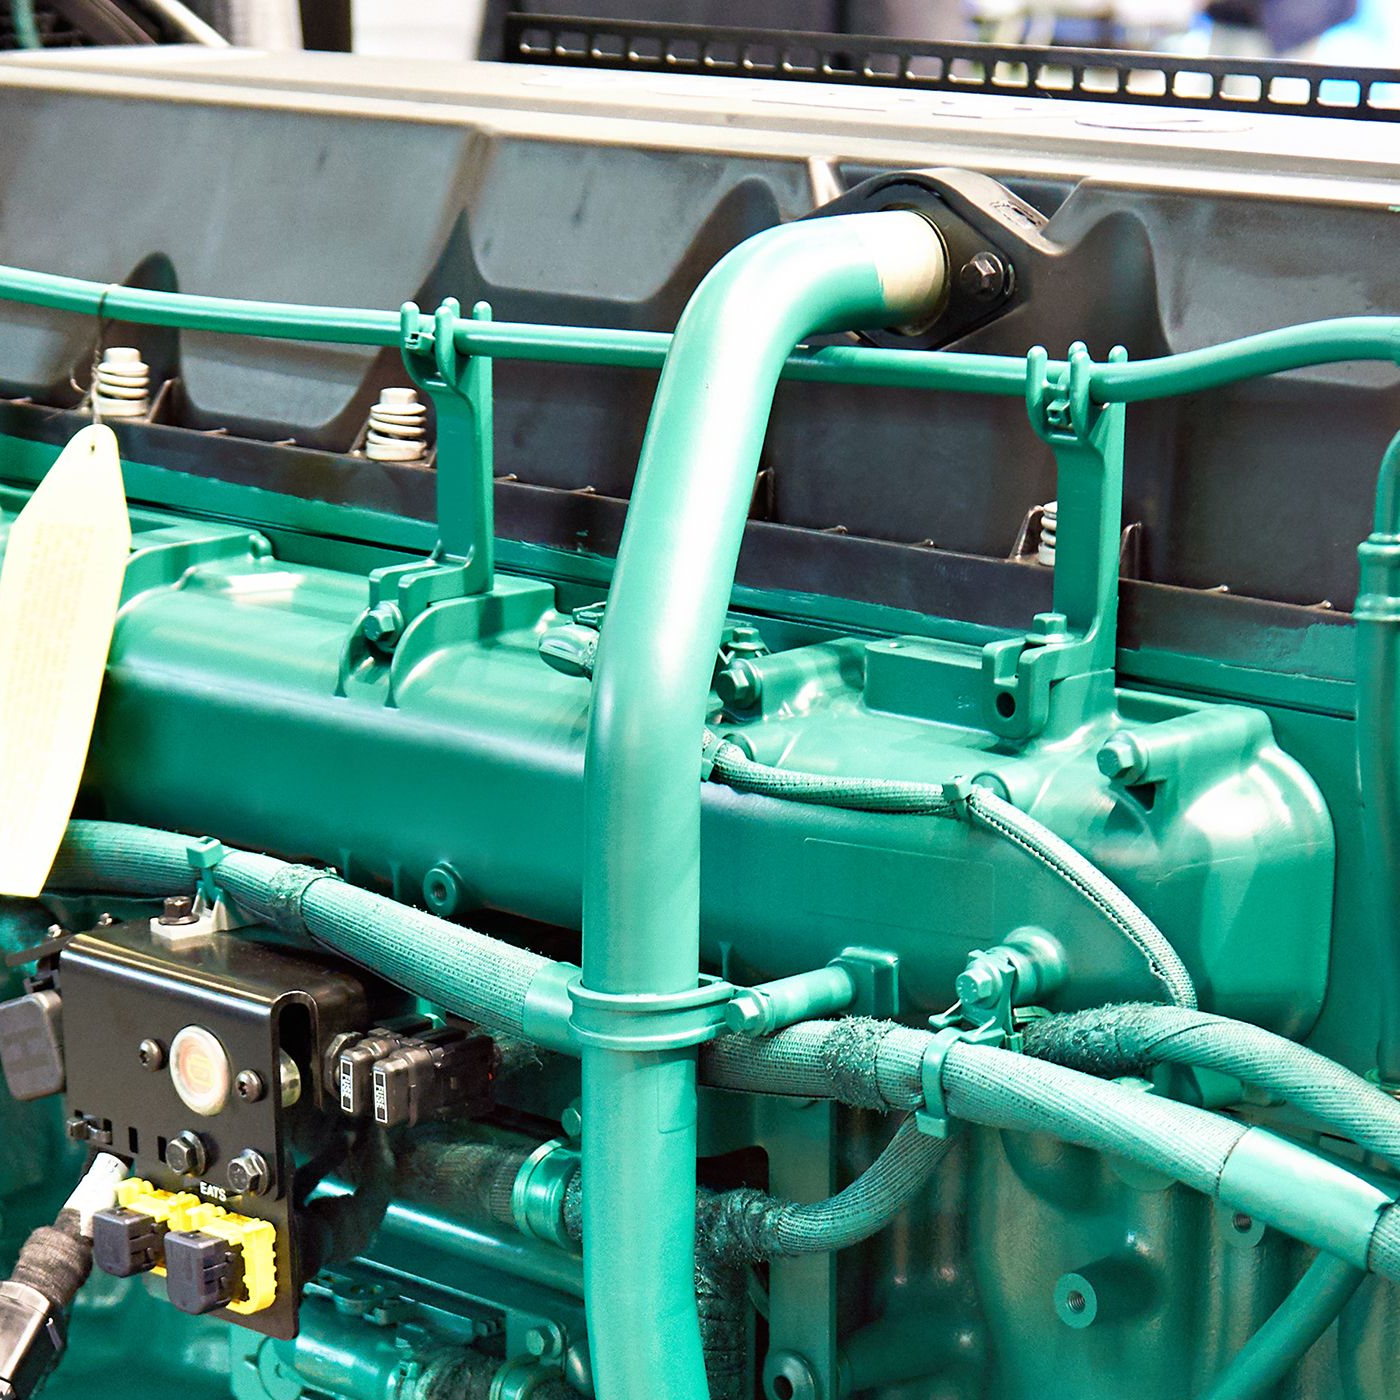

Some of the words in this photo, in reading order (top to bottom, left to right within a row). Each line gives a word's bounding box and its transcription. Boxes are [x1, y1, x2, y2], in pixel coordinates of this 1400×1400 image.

[341, 1074, 352, 1098] FUSE
[375, 1086, 386, 1109] FUSE
[199, 1181, 227, 1202] EATS
